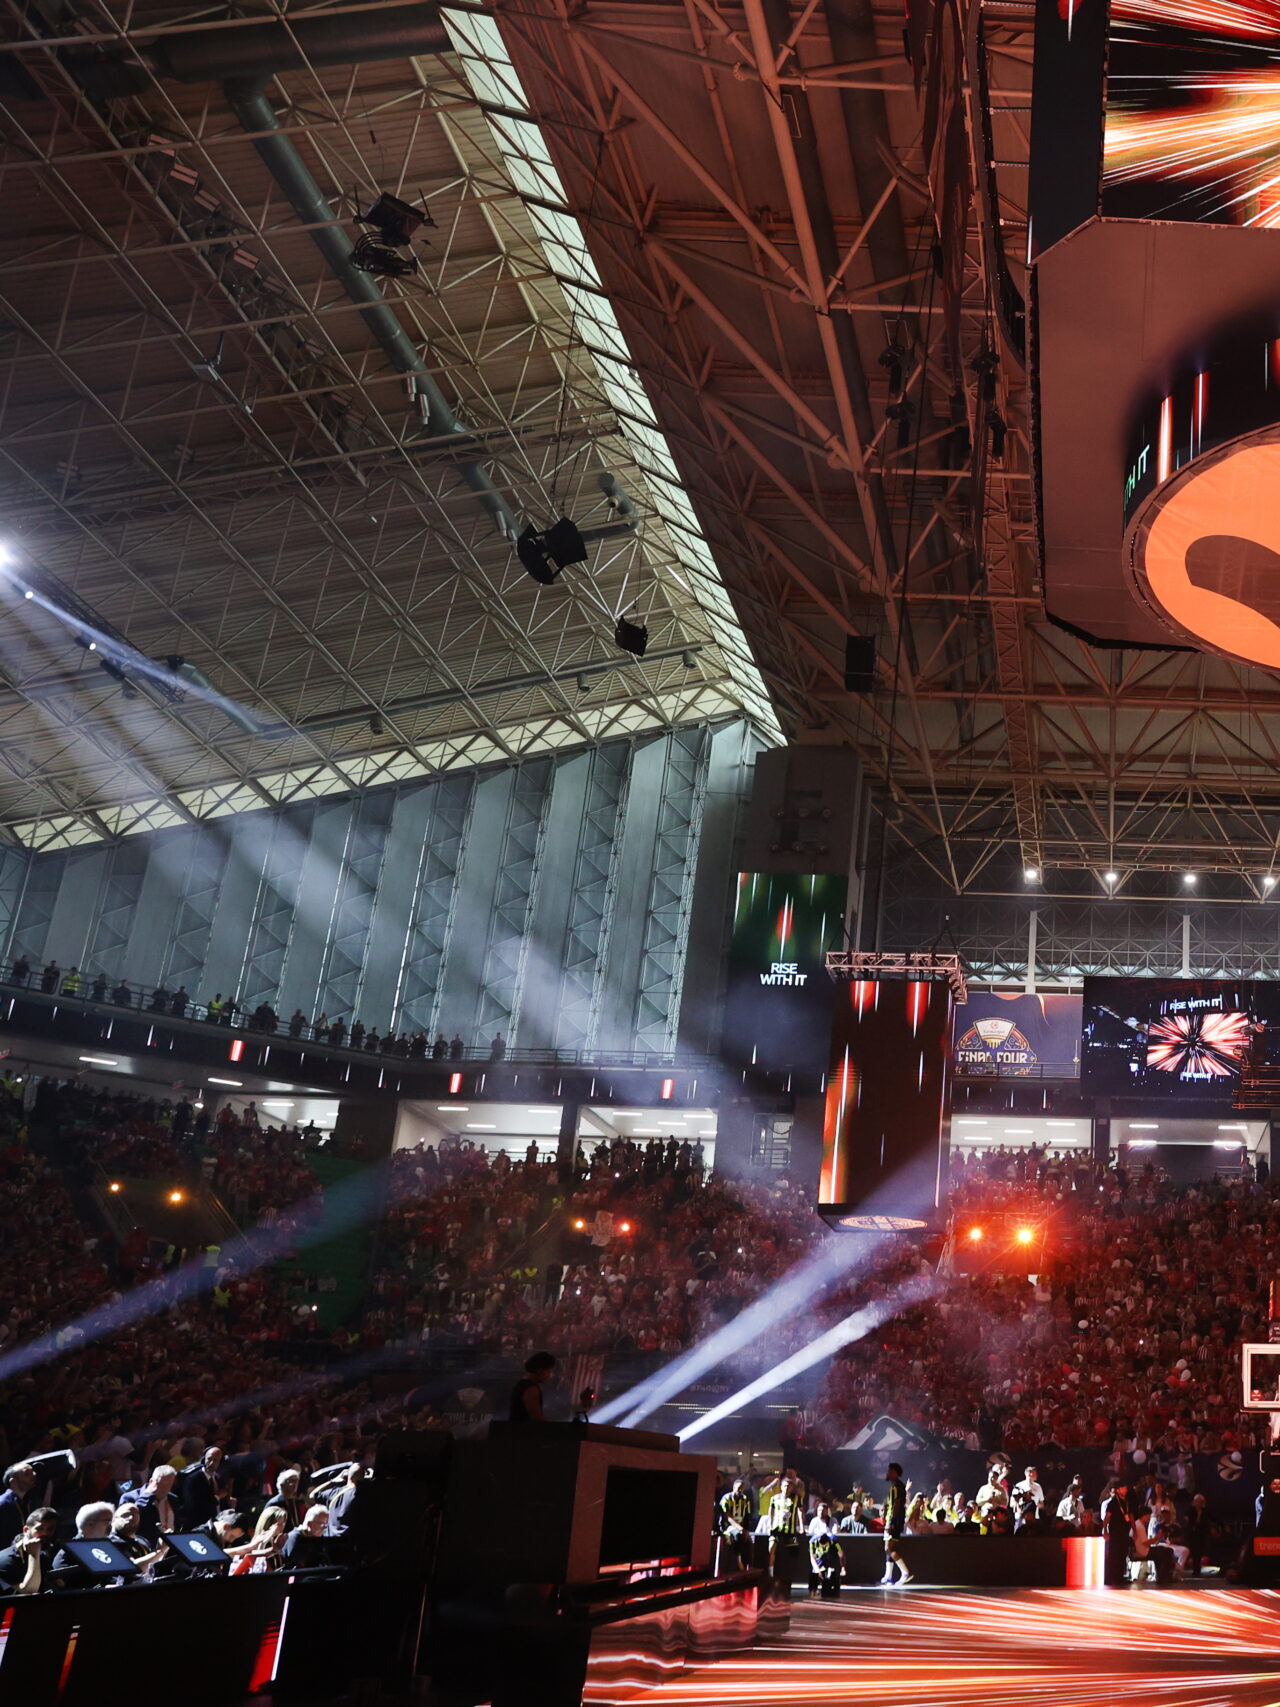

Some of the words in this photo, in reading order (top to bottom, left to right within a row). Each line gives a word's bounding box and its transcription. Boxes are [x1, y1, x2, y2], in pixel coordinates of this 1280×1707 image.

[770, 962, 799, 975] RISE
[759, 973, 793, 986] WITH
[794, 974, 808, 986] IT
[1187, 999, 1211, 1010] WITH
[995, 1051, 1029, 1064] FOUR
